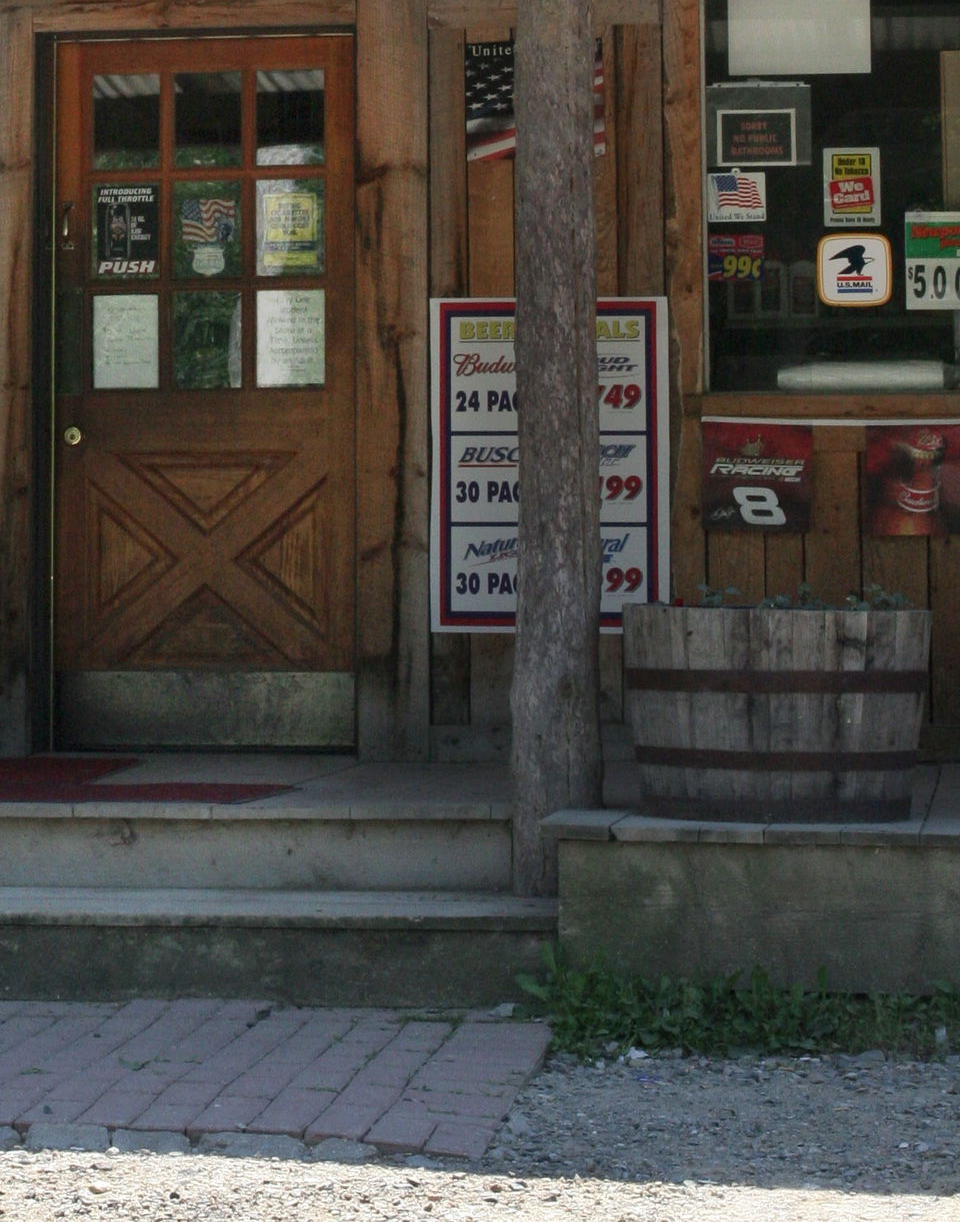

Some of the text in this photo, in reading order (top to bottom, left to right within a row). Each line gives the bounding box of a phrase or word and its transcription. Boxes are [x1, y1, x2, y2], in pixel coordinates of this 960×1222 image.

[472, 45, 513, 57] Unite
[733, 133, 778, 143] NO PUBLIC
[731, 145, 784, 156] BATHROOMS
[844, 167, 869, 175] Tobacco
[100, 187, 153, 196] INTRODUCING
[838, 180, 865, 193] We
[117, 194, 155, 203] THROTTLE
[833, 189, 871, 204] Card
[710, 211, 732, 220] United
[746, 210, 765, 219] Stand
[98, 260, 156, 275] PUSH
[459, 321, 517, 340] BEER
[597, 356, 631, 364] UD
[456, 390, 480, 413] 24
[597, 383, 642, 410] 49
[458, 446, 520, 463] BUSC
[715, 457, 805, 465] BUDWEISER
[709, 464, 804, 477] RACING
[456, 480, 480, 504] 30
[598, 475, 644, 501] 99
[732, 486, 788, 526] 8
[463, 538, 520, 561] Natur
[455, 572, 481, 596] 30
